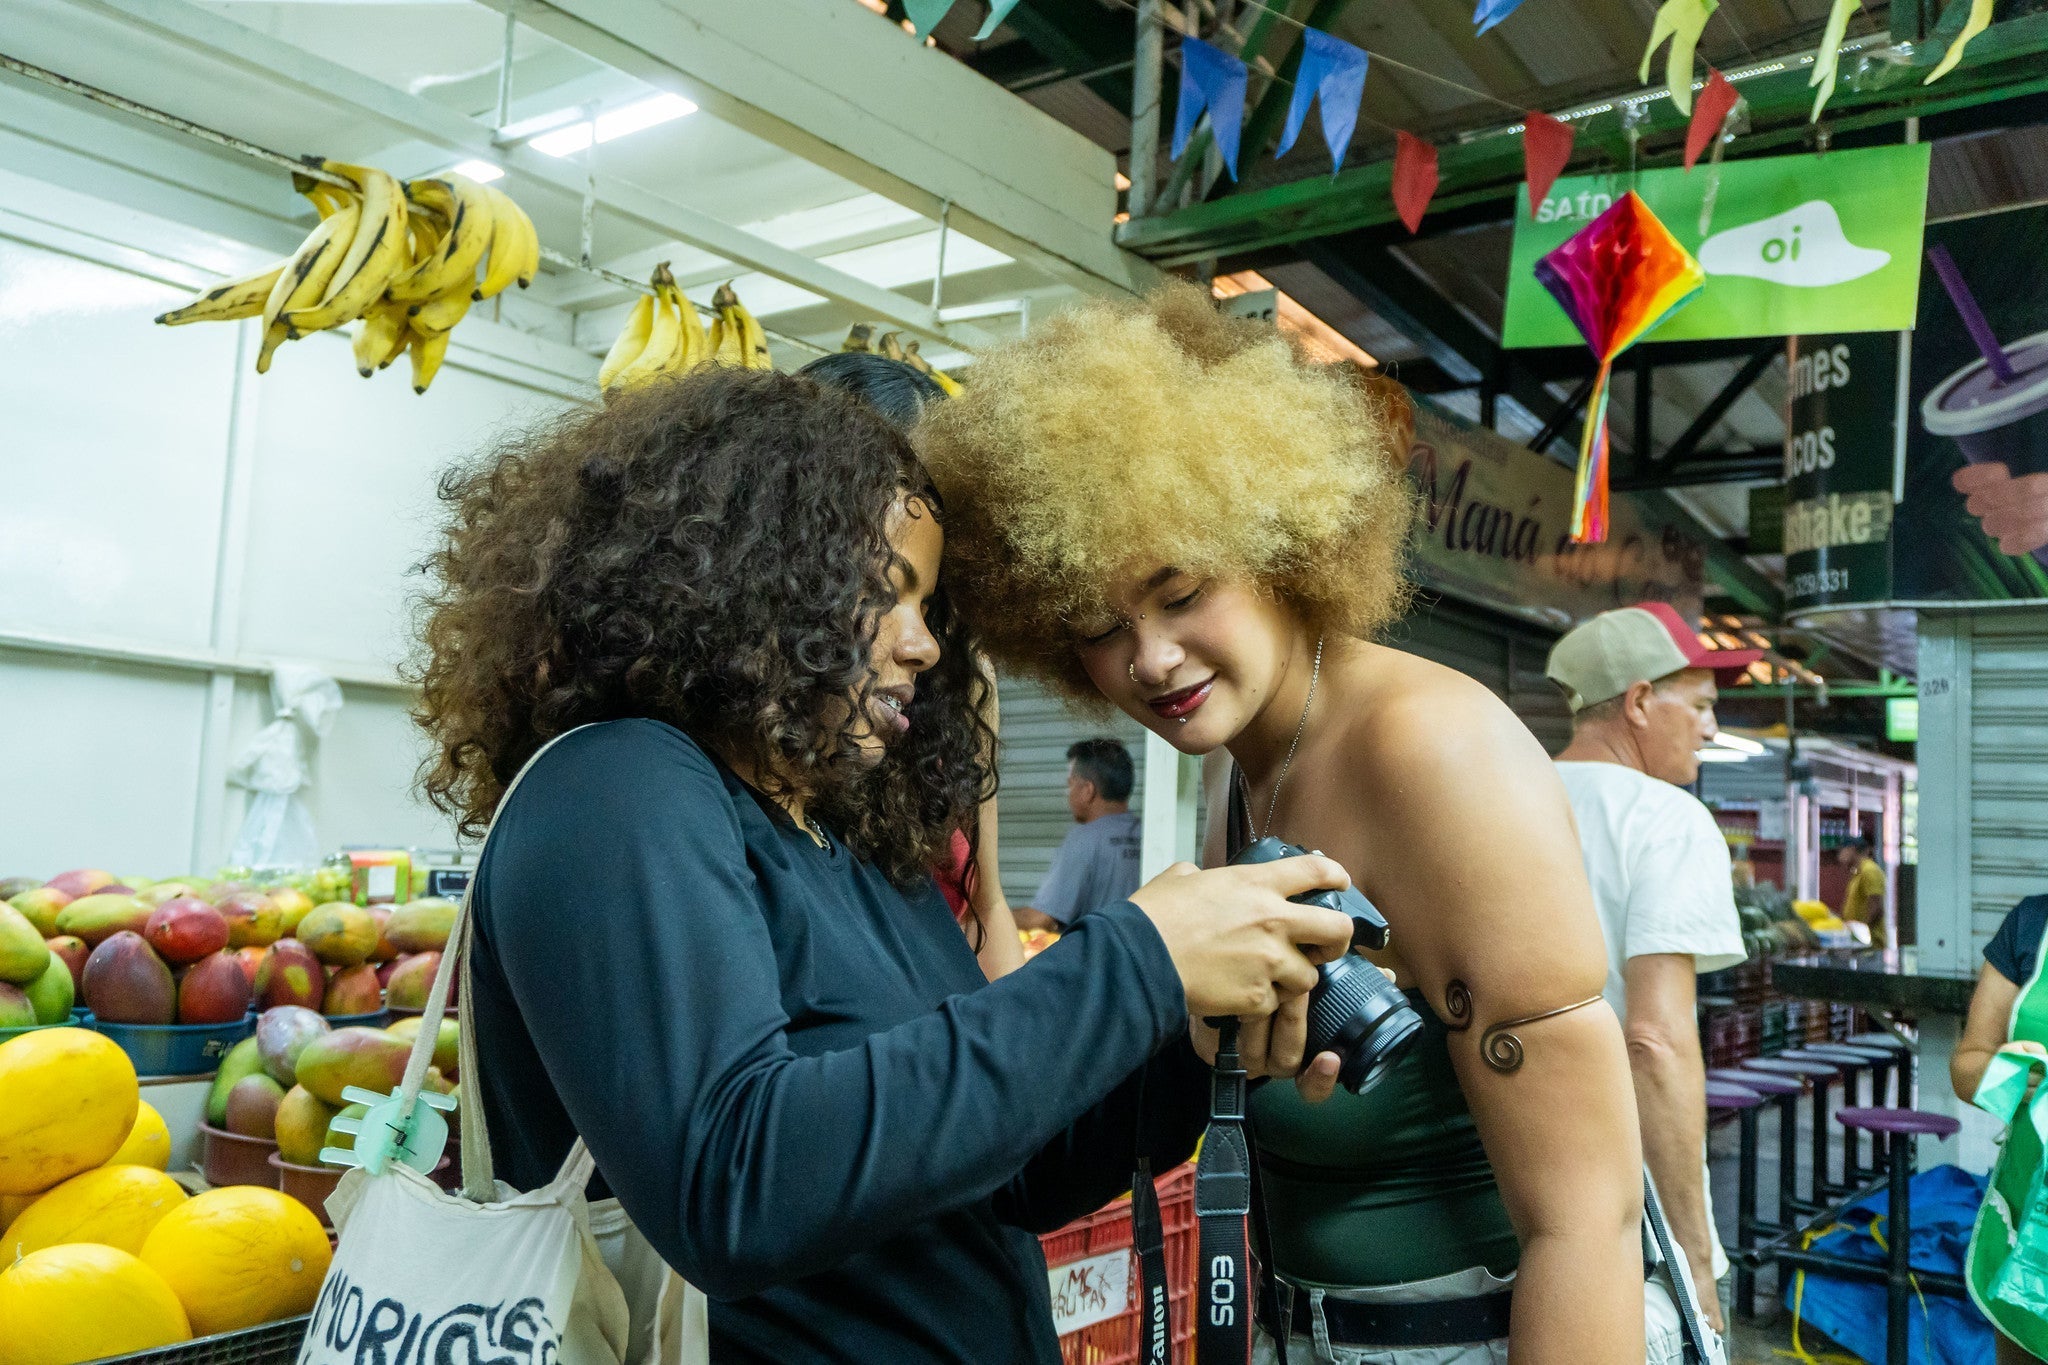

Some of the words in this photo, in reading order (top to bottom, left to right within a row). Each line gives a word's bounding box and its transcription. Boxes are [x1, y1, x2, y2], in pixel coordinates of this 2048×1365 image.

[1537, 190, 1625, 223] SAÍD
[1761, 225, 1802, 264] oi
[1408, 441, 1541, 567] Maná
[1150, 1286, 1165, 1365] anon
[1210, 1254, 1235, 1327] EOS
